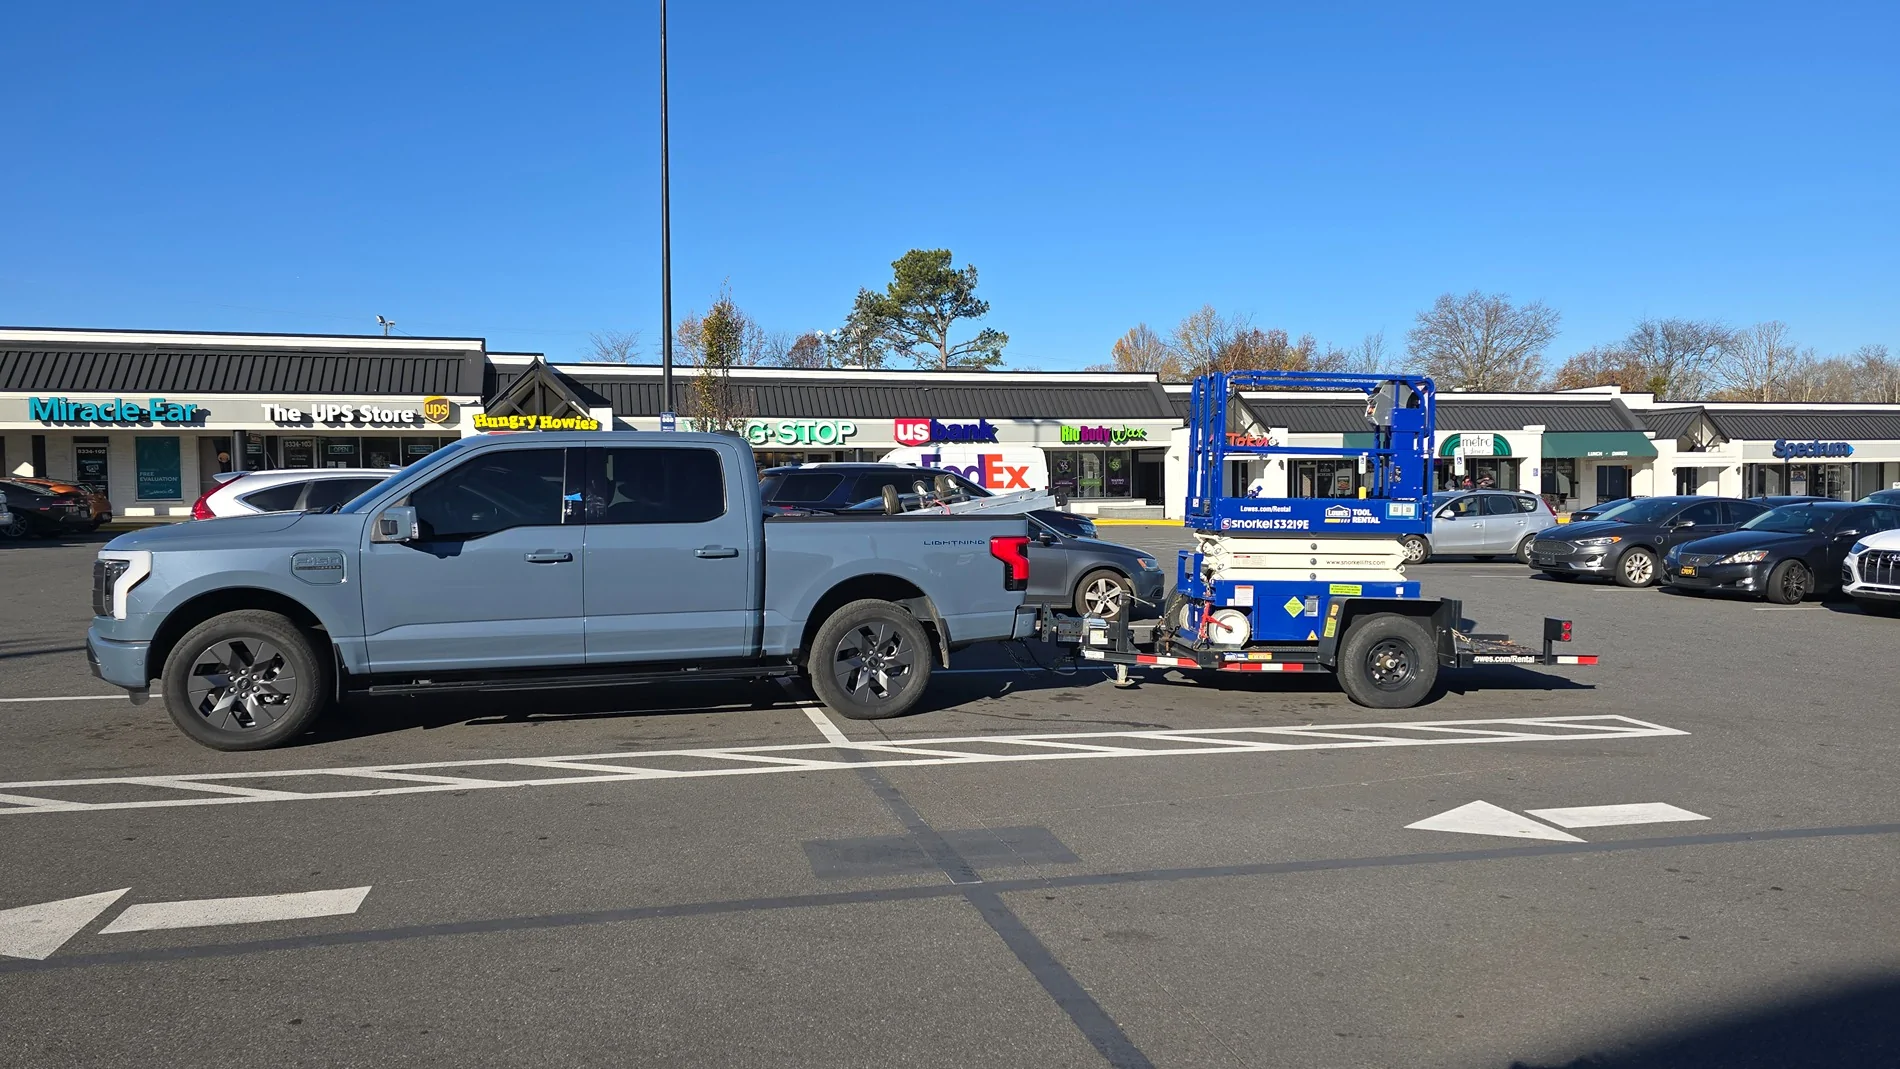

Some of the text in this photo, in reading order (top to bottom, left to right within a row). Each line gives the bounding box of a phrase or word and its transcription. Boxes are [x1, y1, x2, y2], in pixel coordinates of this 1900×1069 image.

[28, 397, 197, 422] Miracle-Ear
[261, 403, 414, 423] The UPS Store
[425, 402, 449, 420] ups
[473, 414, 598, 430] Hungry Howie's
[896, 418, 997, 442] us bank
[1061, 424, 1146, 443] Rio Body Wax
[1462, 435, 1492, 447] metro
[1773, 438, 1850, 462] Spectrum
[1352, 508, 1373, 516] TOOL
[1352, 516, 1381, 524] RENTAL
[1231, 519, 1273, 529] snorkel
[923, 539, 986, 547] LIGHTNING
[1473, 655, 1535, 663] owes.com/Rental
